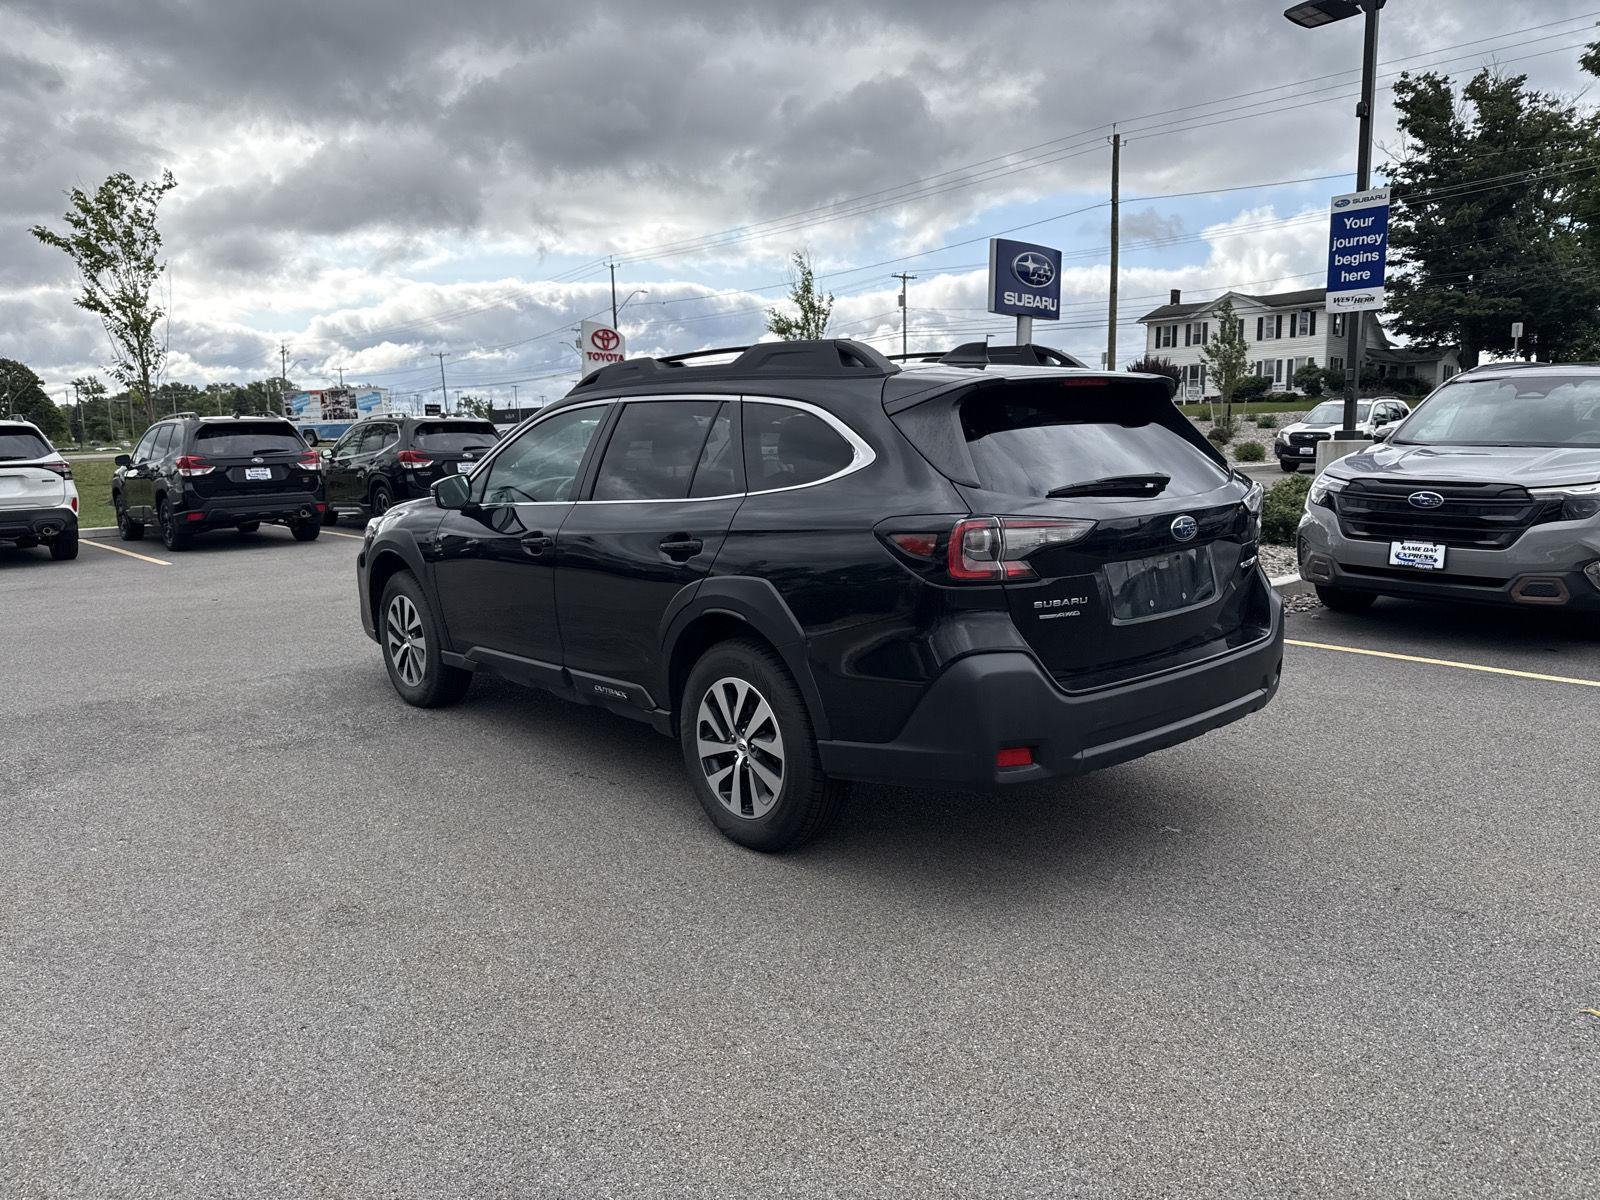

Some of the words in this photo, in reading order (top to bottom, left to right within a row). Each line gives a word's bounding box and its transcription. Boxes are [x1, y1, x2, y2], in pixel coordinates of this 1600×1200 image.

[1352, 194, 1386, 204] SUBARU
[1344, 216, 1374, 229] Your
[1332, 233, 1383, 251] journey
[1335, 251, 1379, 266] begins
[1341, 270, 1371, 282] here
[1003, 291, 1057, 311] SUBARU
[587, 351, 625, 362] TOYOTA
[1397, 551, 1435, 559] EXPRESS
[1033, 596, 1088, 608] SUBARU
[1056, 610, 1080, 618] AWD
